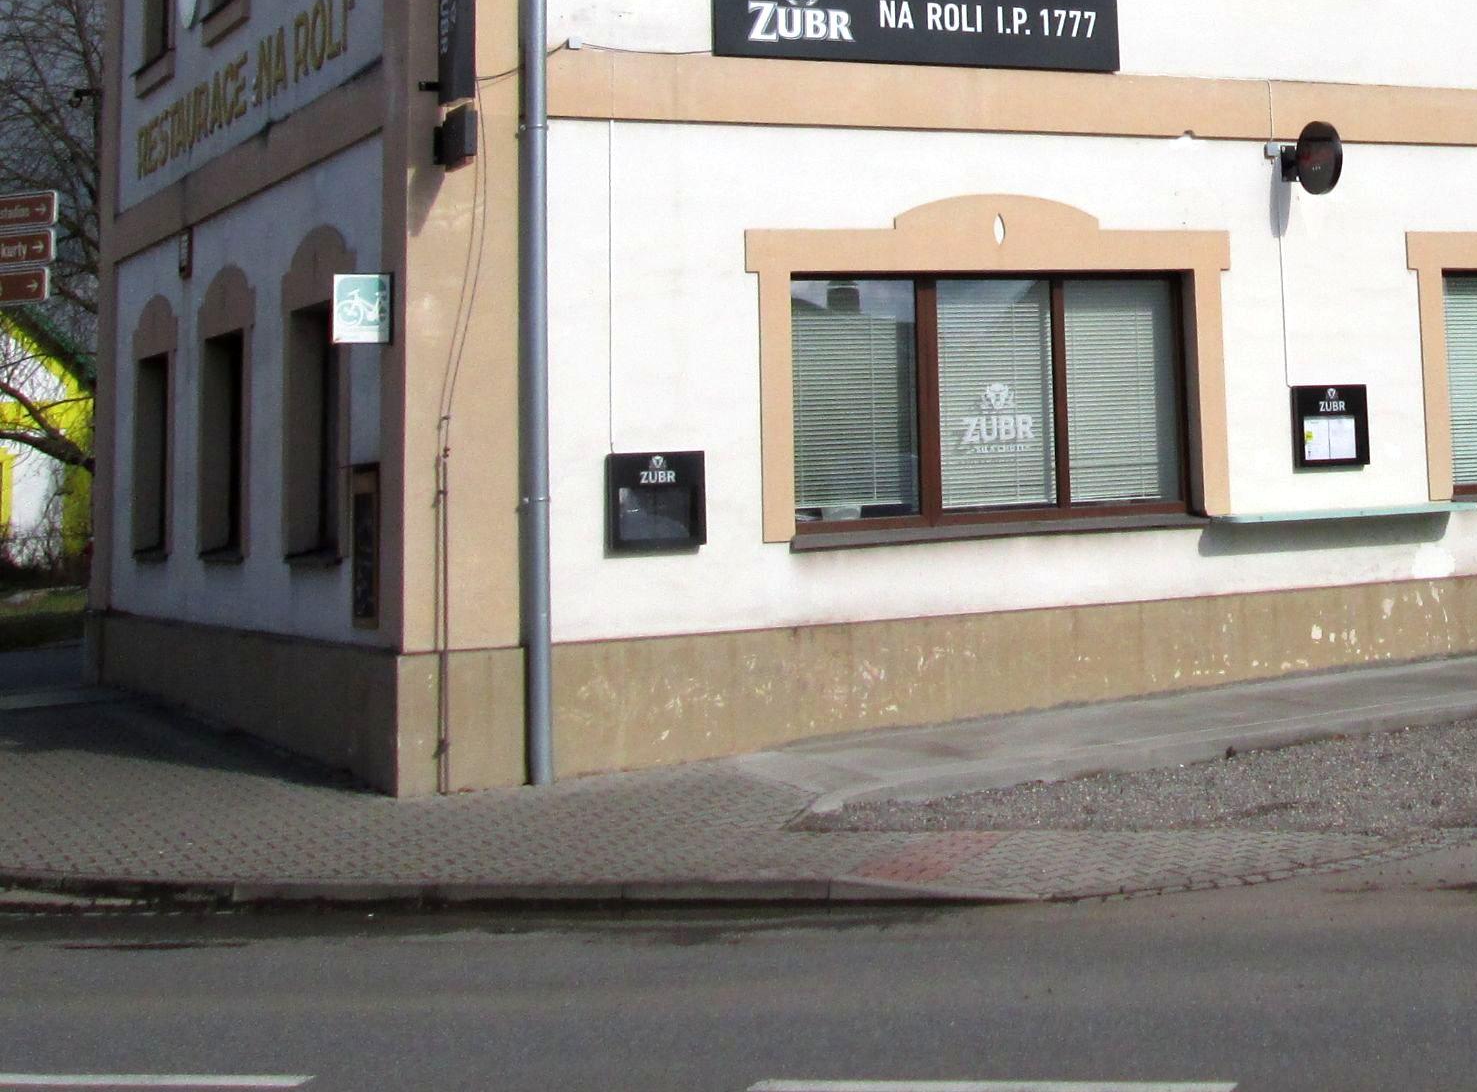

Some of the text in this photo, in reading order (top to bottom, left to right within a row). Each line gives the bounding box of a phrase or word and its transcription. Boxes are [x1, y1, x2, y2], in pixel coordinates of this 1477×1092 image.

[748, 0, 856, 42] ZUBR
[879, 0, 1097, 39] NA ROLI I.P. 1777
[137, 50, 249, 181] RESTAURACE
[1319, 400, 1346, 412] ZUBR
[962, 414, 1035, 444] ZUBR
[640, 470, 676, 484] ZUBR
